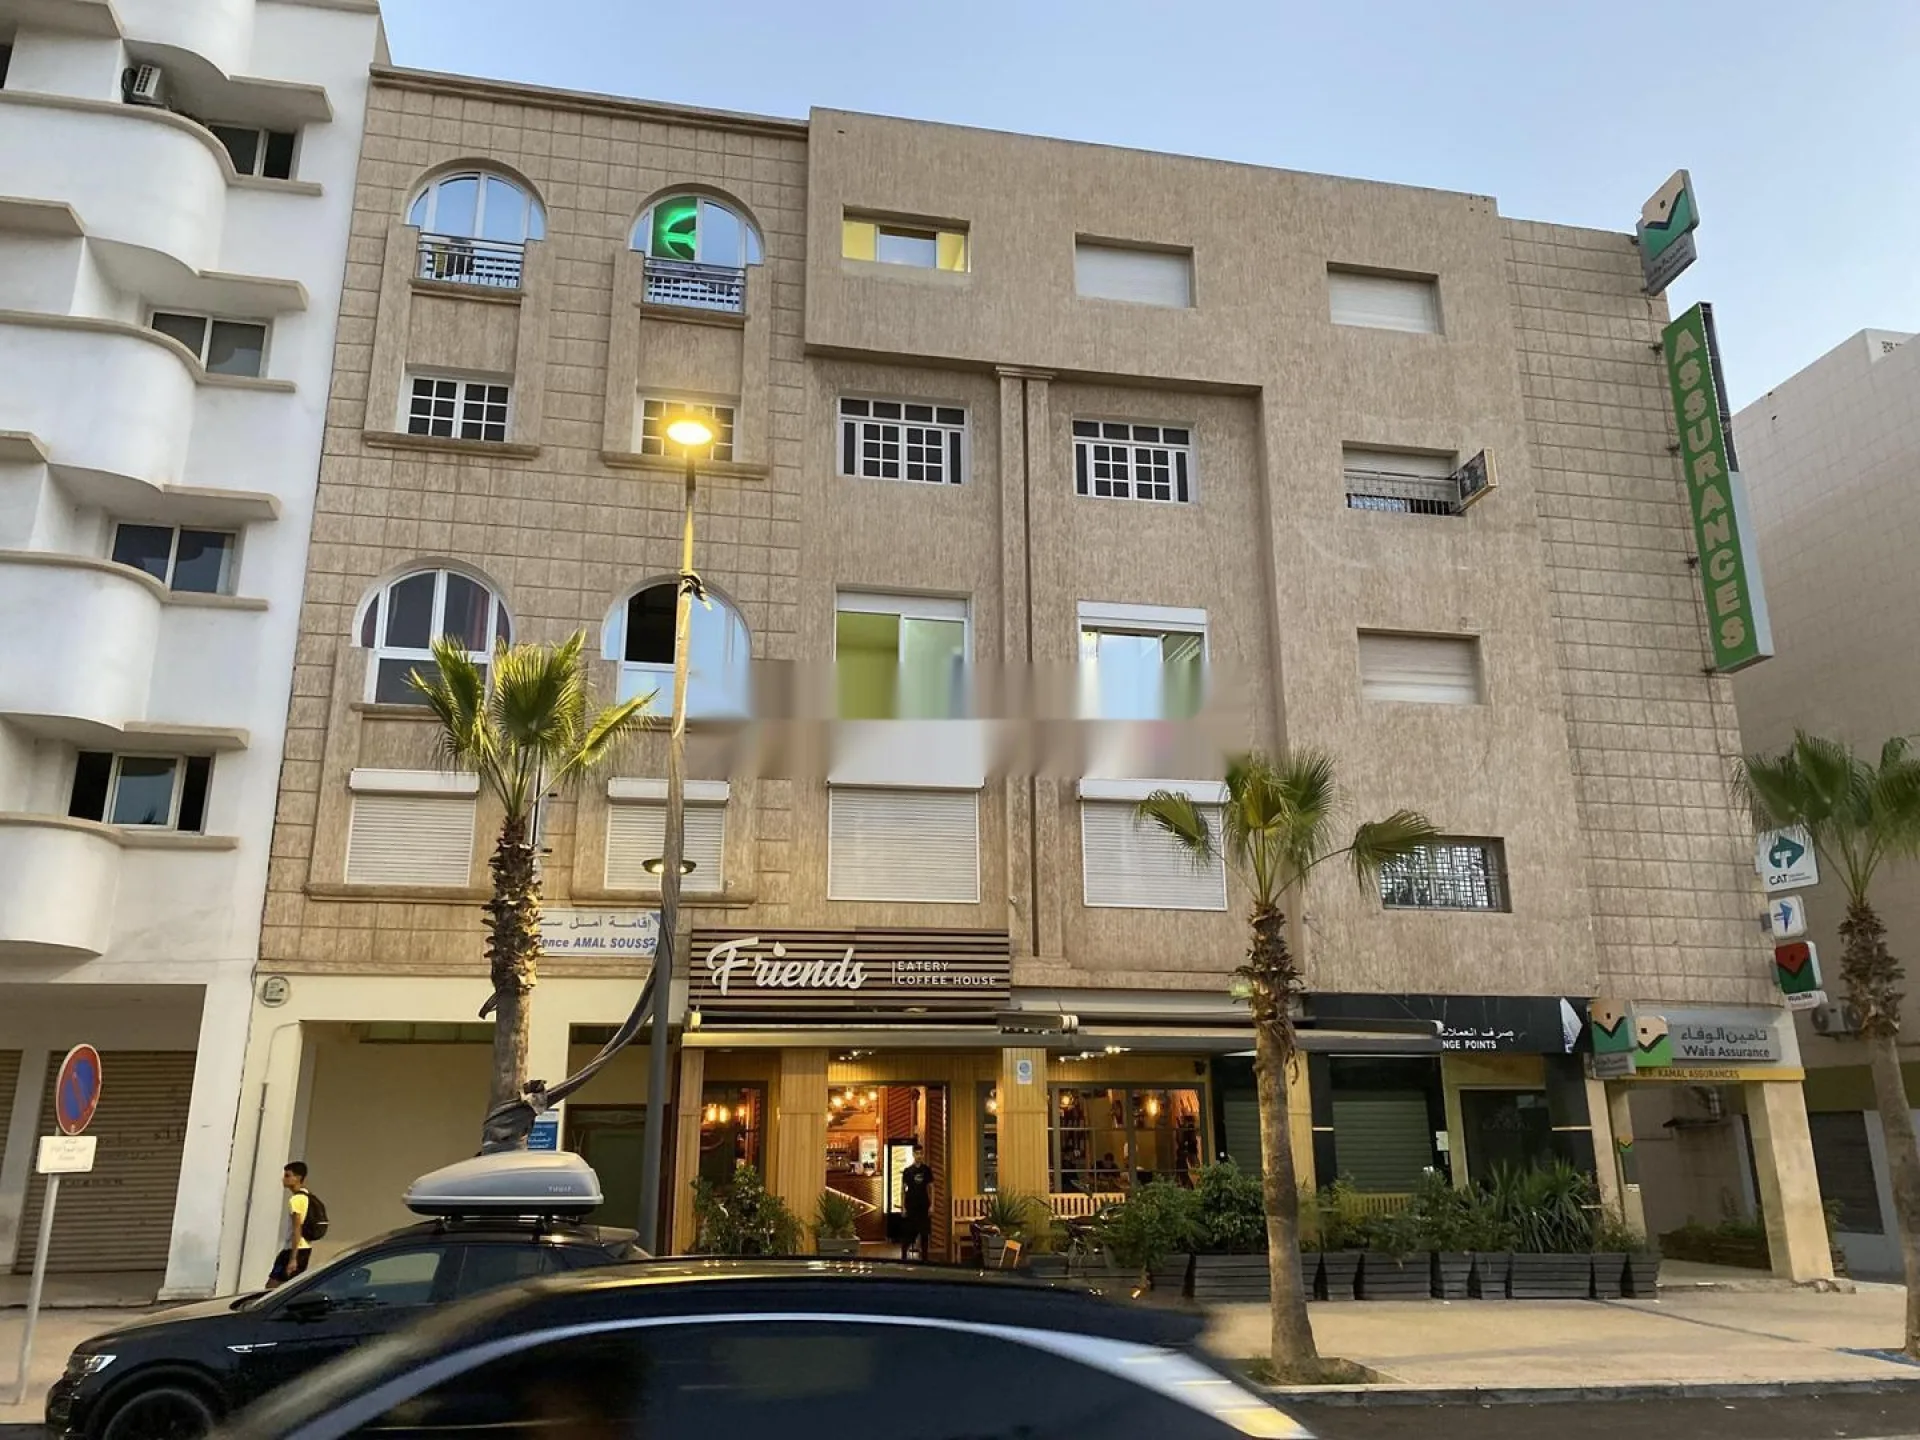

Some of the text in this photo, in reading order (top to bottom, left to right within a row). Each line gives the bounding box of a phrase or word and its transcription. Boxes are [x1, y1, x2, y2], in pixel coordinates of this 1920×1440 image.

[1673, 327, 1746, 650] ASSURANCES
[1768, 873, 1788, 885] CAT
[573, 937, 606, 949] AMAL
[706, 936, 868, 996] Friends
[898, 960, 949, 972] EATERY
[898, 974, 996, 985] COFFEE HOUSE
[1681, 1026, 1725, 1044] الوفاء
[1464, 1039, 1497, 1049] POINTS
[1682, 1044, 1770, 1058] Wafa Assurance
[1689, 1067, 1740, 1079] ASSURANCES
